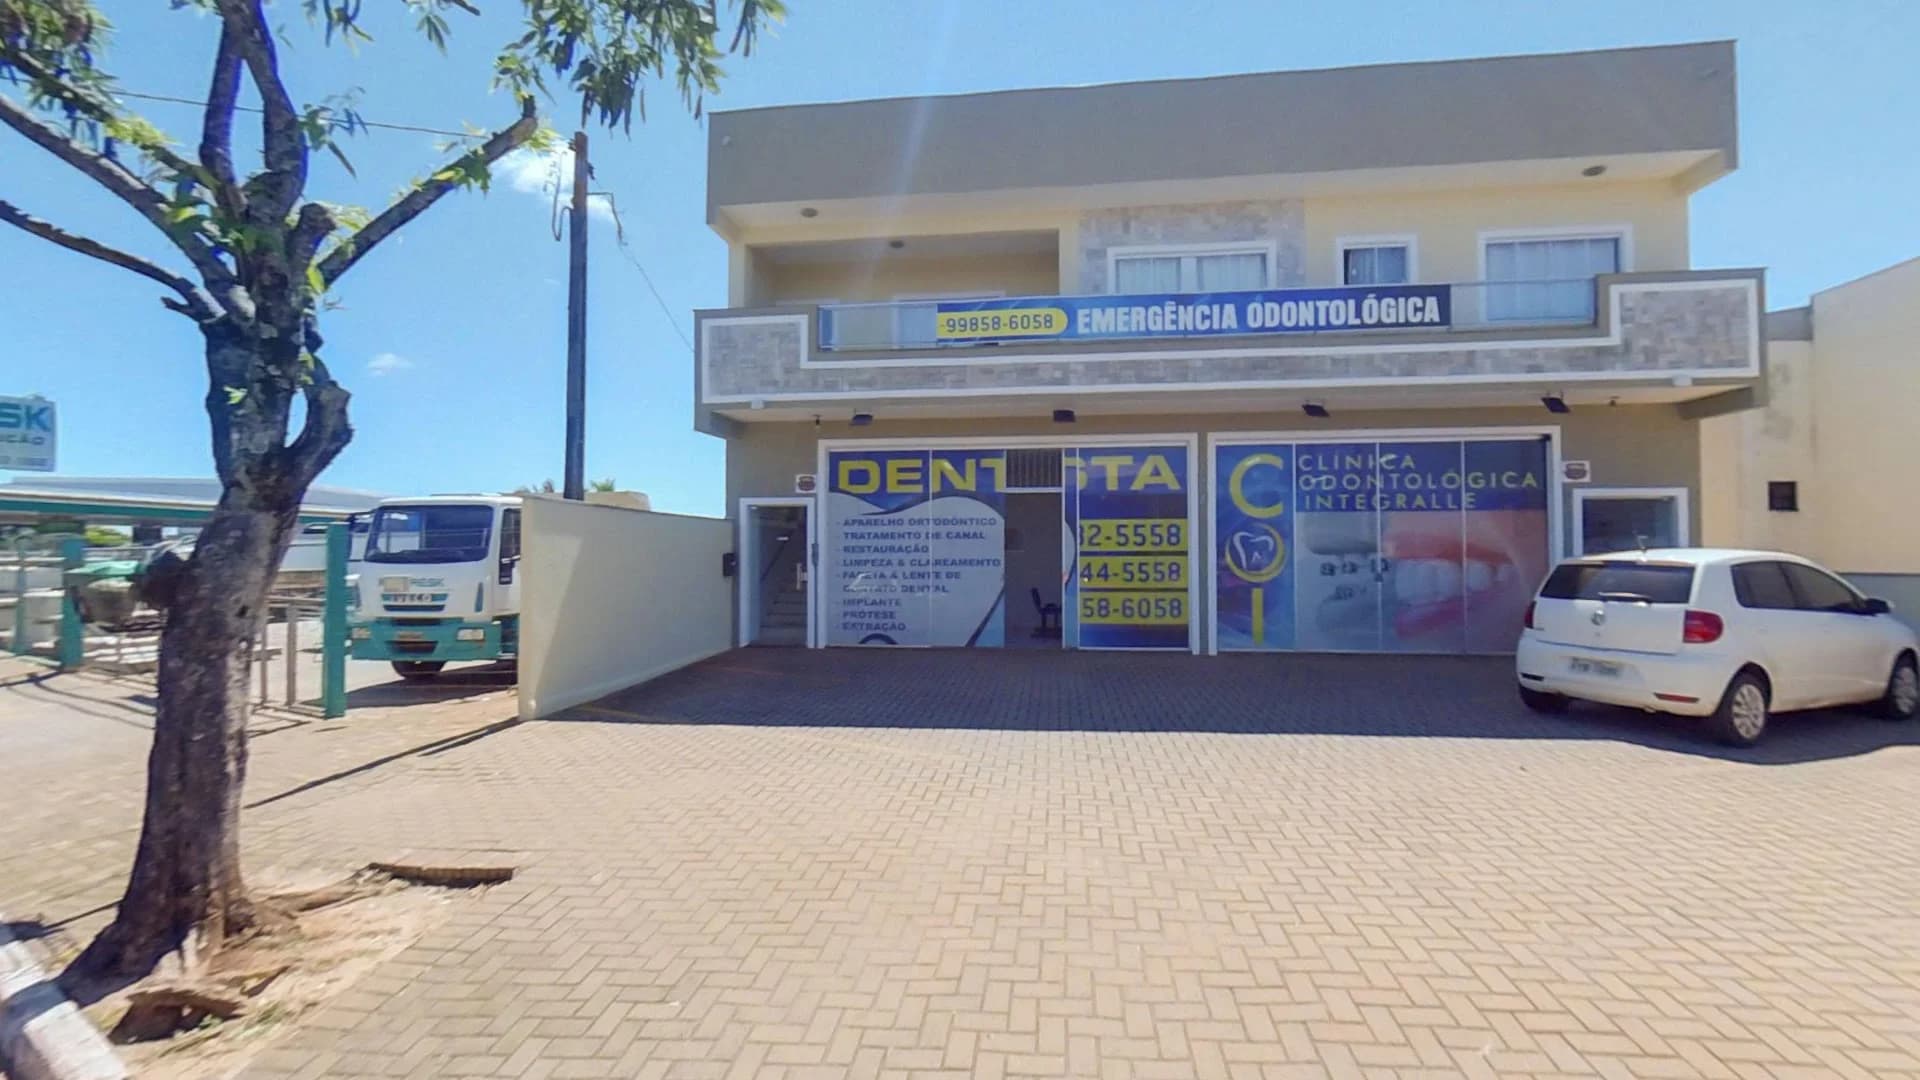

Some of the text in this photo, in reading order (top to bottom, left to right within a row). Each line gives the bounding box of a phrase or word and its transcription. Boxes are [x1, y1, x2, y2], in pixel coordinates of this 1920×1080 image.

[1077, 301, 1238, 334] EMERGÊNCIA
[1247, 294, 1440, 328] ODONTOLÓGICA
[1299, 470, 1536, 491] ODONTOLÓGICA
[1305, 492, 1476, 510] INTEGRALLE
[843, 517, 997, 527] APARELHO ORTODÔNTICO
[843, 531, 985, 540] TRATAMENTO DE CANAL
[843, 543, 929, 554] RESTAURAÇÃO
[843, 559, 893, 567] LIMPEZA
[910, 558, 1000, 567] CLAREAMENTO
[902, 571, 943, 580] LENTE
[945, 571, 961, 579] DE
[901, 584, 949, 592] DENTAL
[843, 599, 901, 607] IMPLANTE
[1083, 598, 1182, 618] 58-6058
[843, 609, 896, 619] PRÓTESE
[843, 621, 906, 632] EXTRAÇÃO
